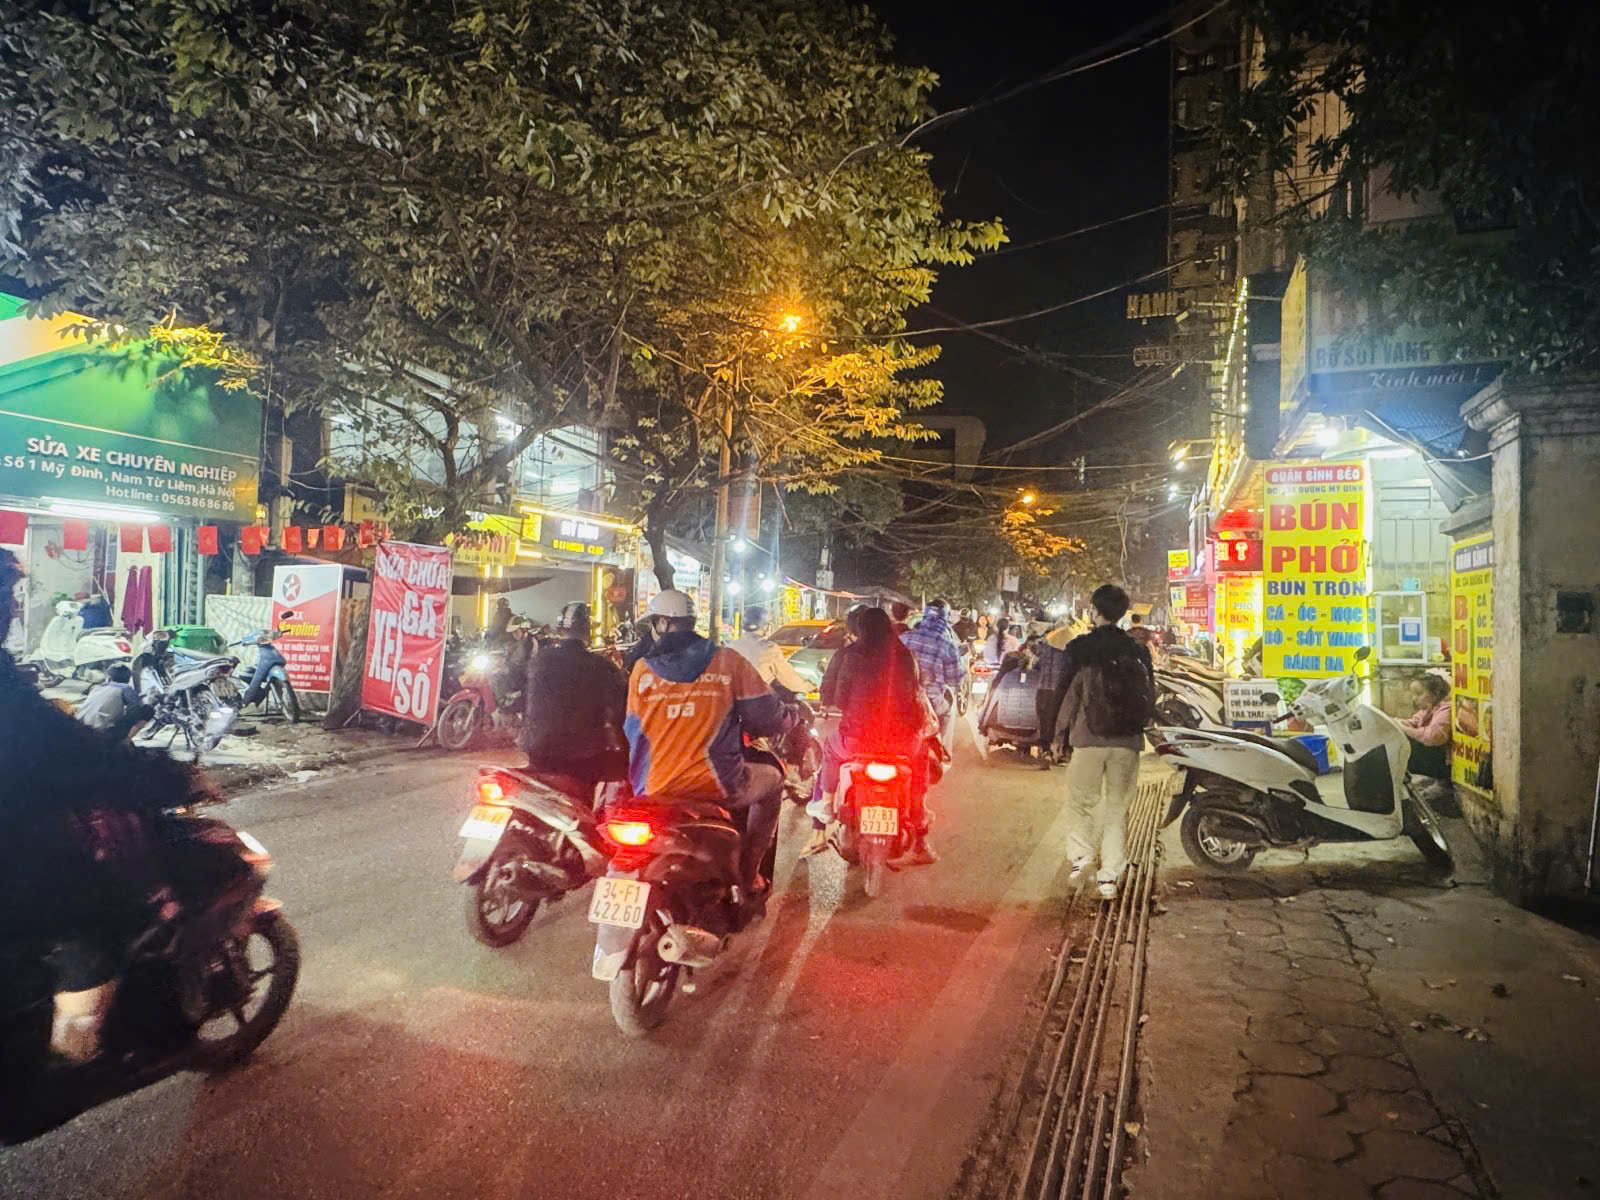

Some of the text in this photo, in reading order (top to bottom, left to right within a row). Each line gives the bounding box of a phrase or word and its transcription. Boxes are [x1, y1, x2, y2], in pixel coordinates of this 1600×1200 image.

[27, 433, 237, 486] SỬA XE CHUYÊN NGHIỆP
[30, 458, 36, 471] 1
[41, 461, 65, 479] Mỹ
[111, 473, 143, 485] Nam
[147, 475, 165, 488] Từ
[217, 486, 236, 500] Nội
[1269, 498, 1359, 531] BÚN
[408, 555, 448, 589] CHỮA
[1271, 538, 1361, 574] PHỞ
[1267, 578, 1367, 598] BÚN TRỘN
[403, 590, 437, 639] GA
[394, 657, 434, 719] SỐ
[603, 881, 641, 903] 34-F1
[593, 899, 642, 924] 422.60
